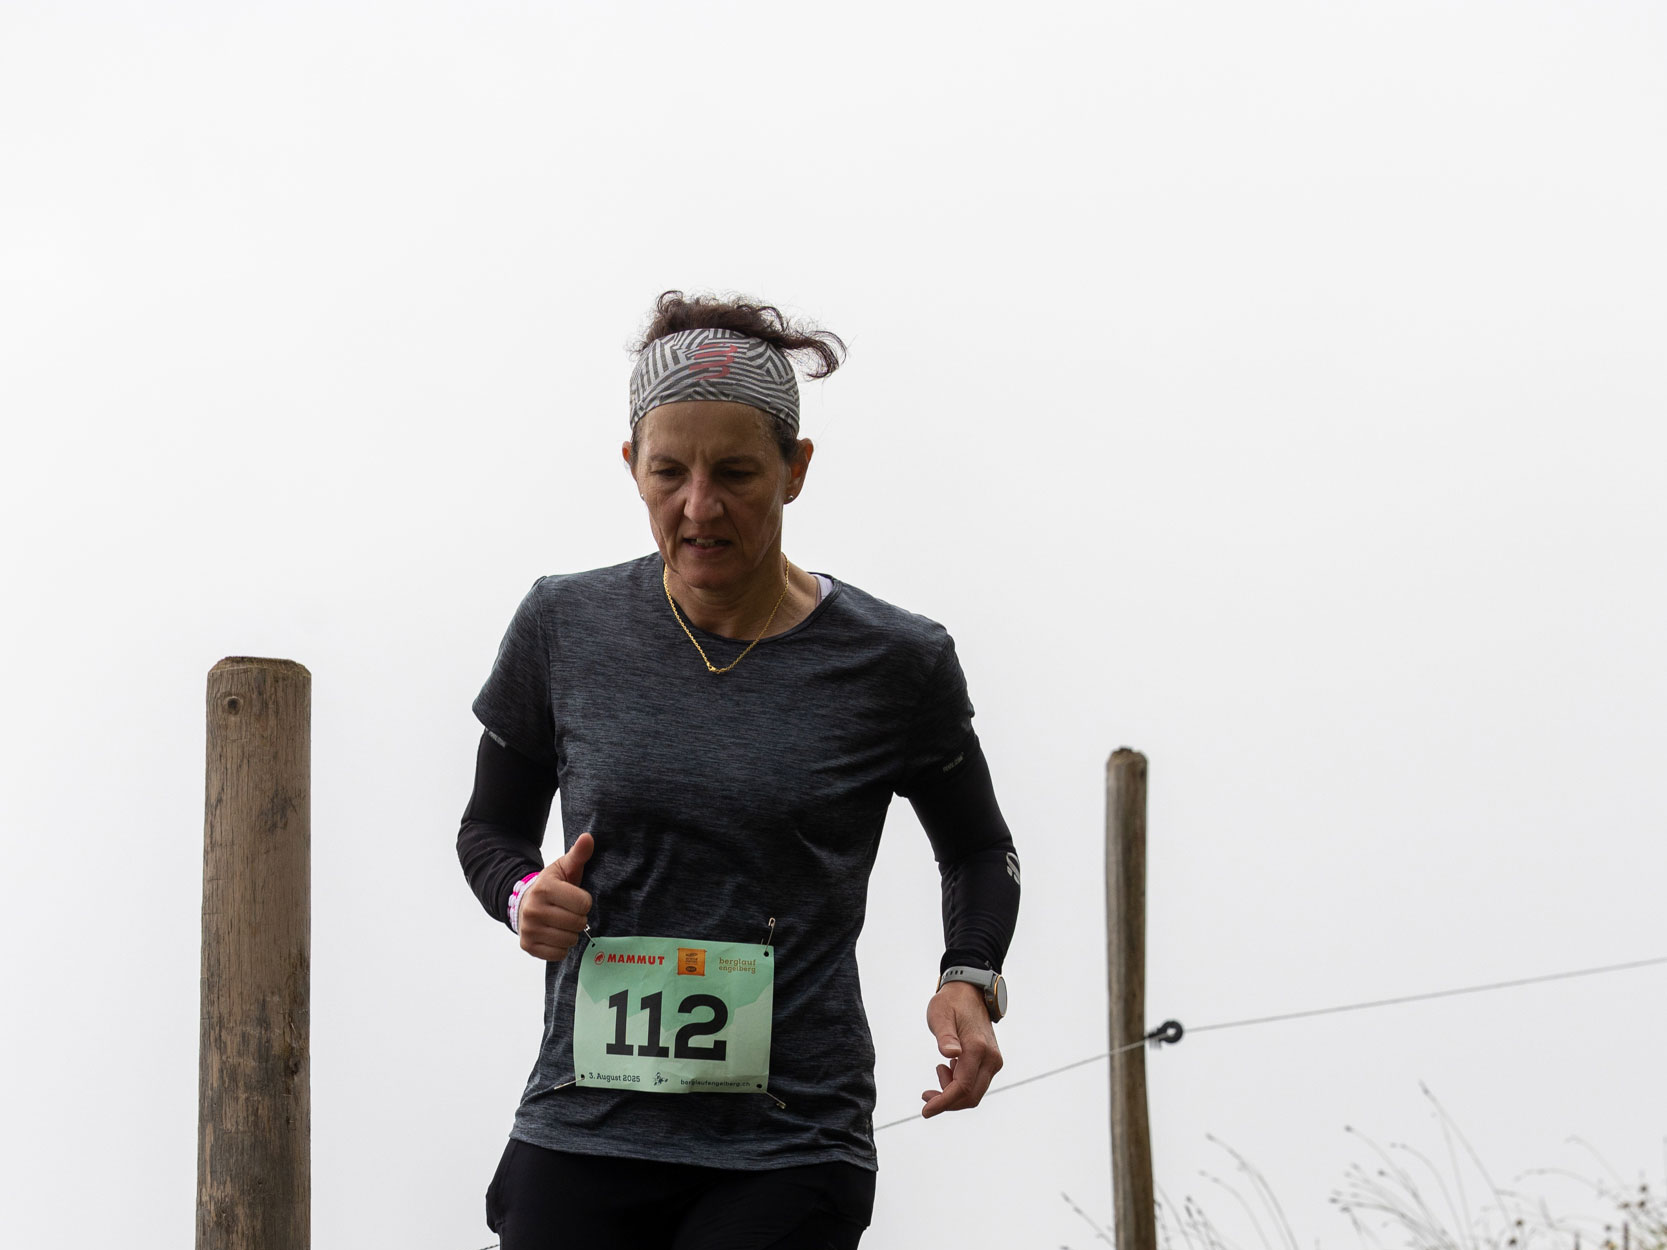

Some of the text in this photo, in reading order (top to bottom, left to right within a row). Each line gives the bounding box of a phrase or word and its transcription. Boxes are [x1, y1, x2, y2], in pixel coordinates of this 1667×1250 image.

[607, 953, 665, 966] MAMMUT
[719, 957, 756, 967] berglauf
[719, 965, 756, 975] engelberg
[606, 989, 729, 1061] 112
[588, 1072, 641, 1083] 3. August 2025
